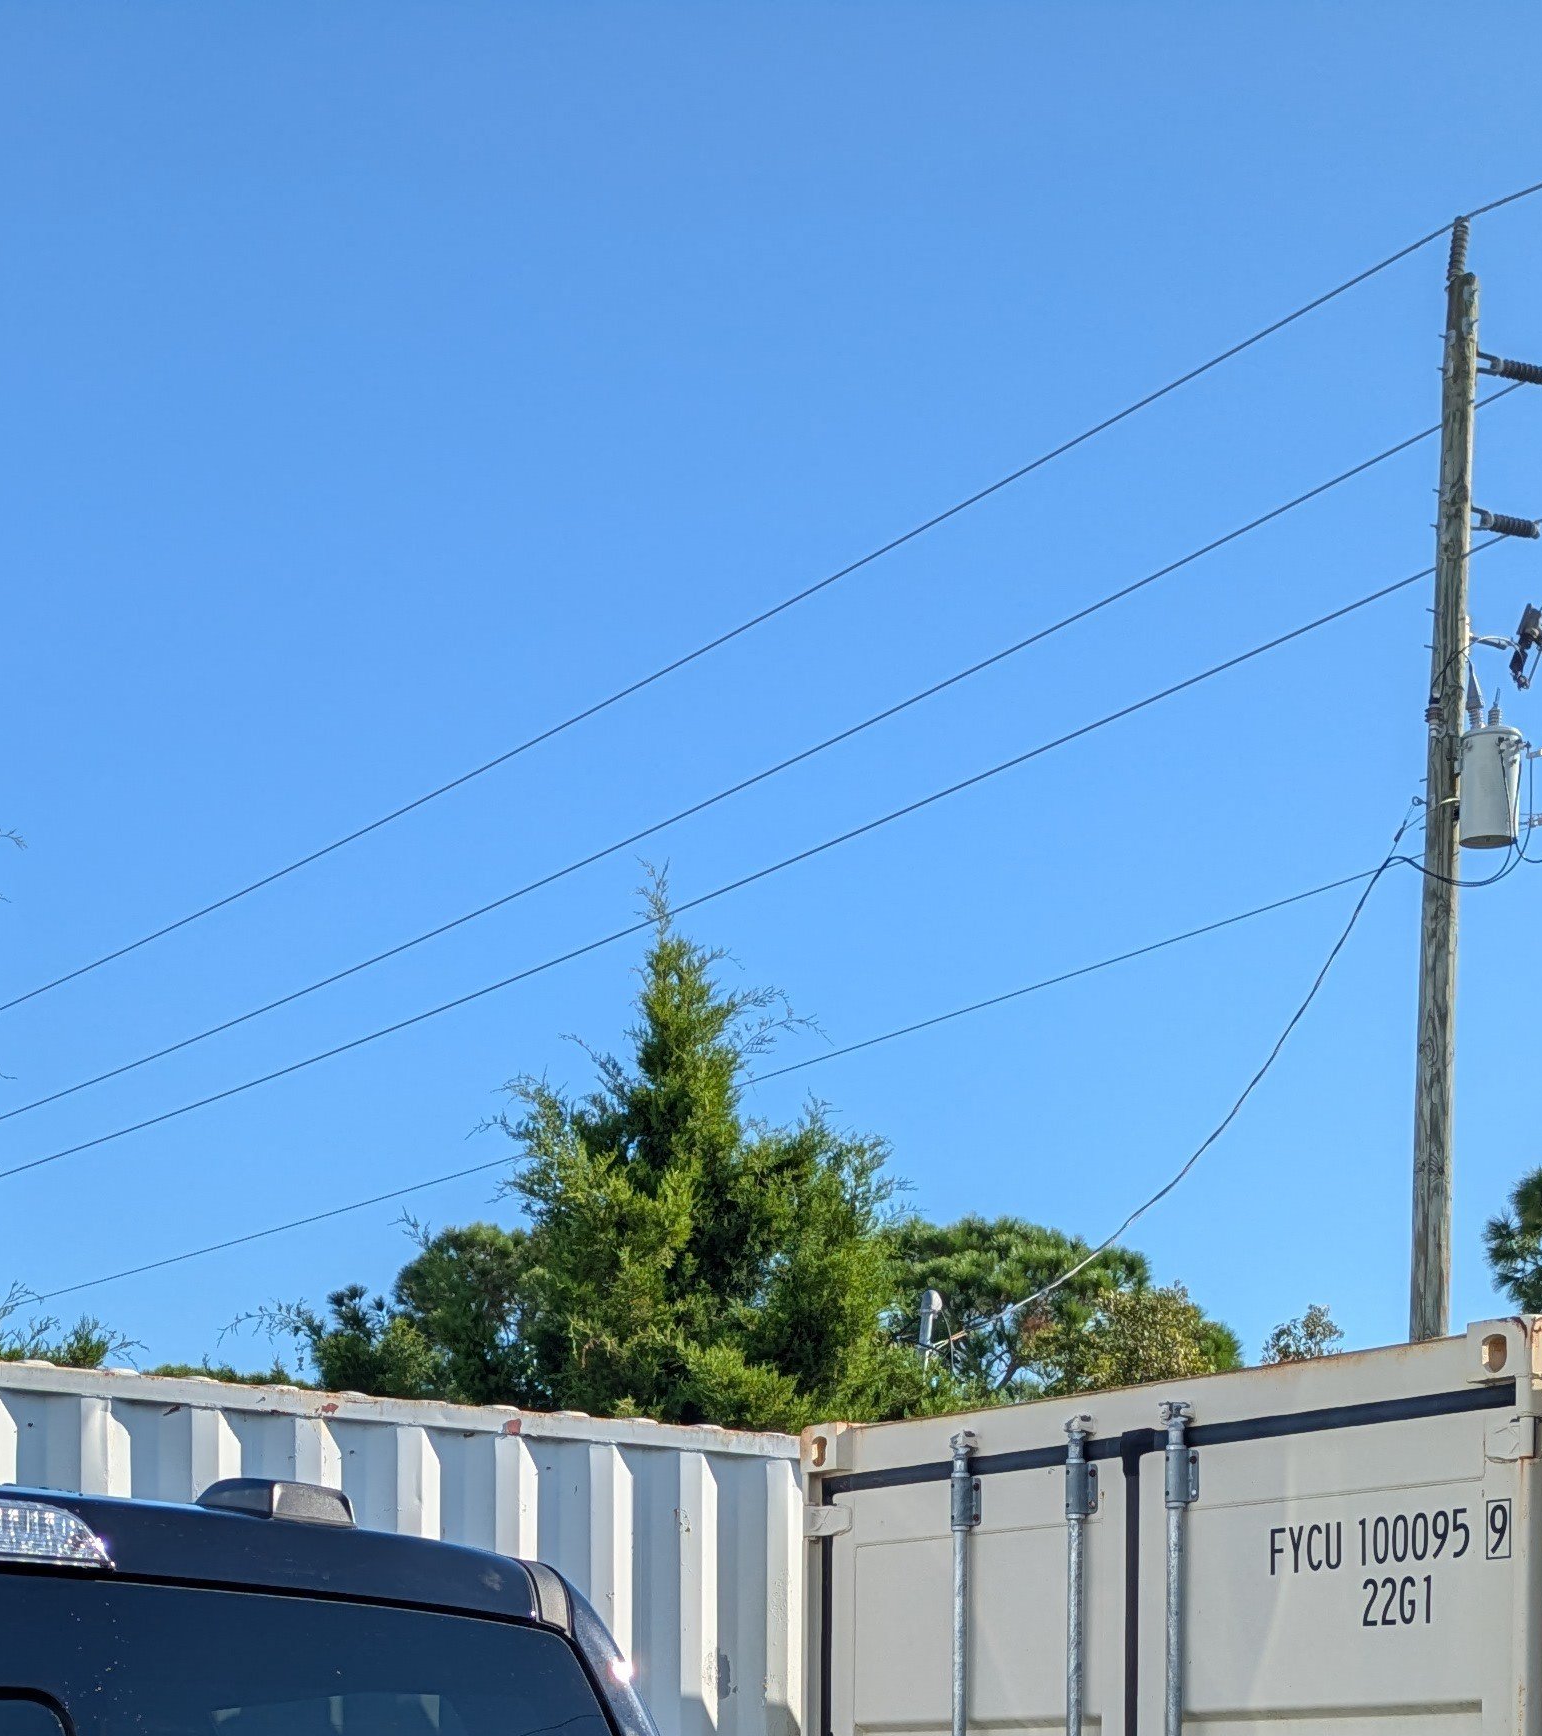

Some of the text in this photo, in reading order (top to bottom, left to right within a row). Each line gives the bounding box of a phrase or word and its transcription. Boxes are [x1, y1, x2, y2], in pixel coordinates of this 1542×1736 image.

[1271, 1505, 1507, 1575] FYCU 100095 9
[1363, 1575, 1431, 1626] 22G1
